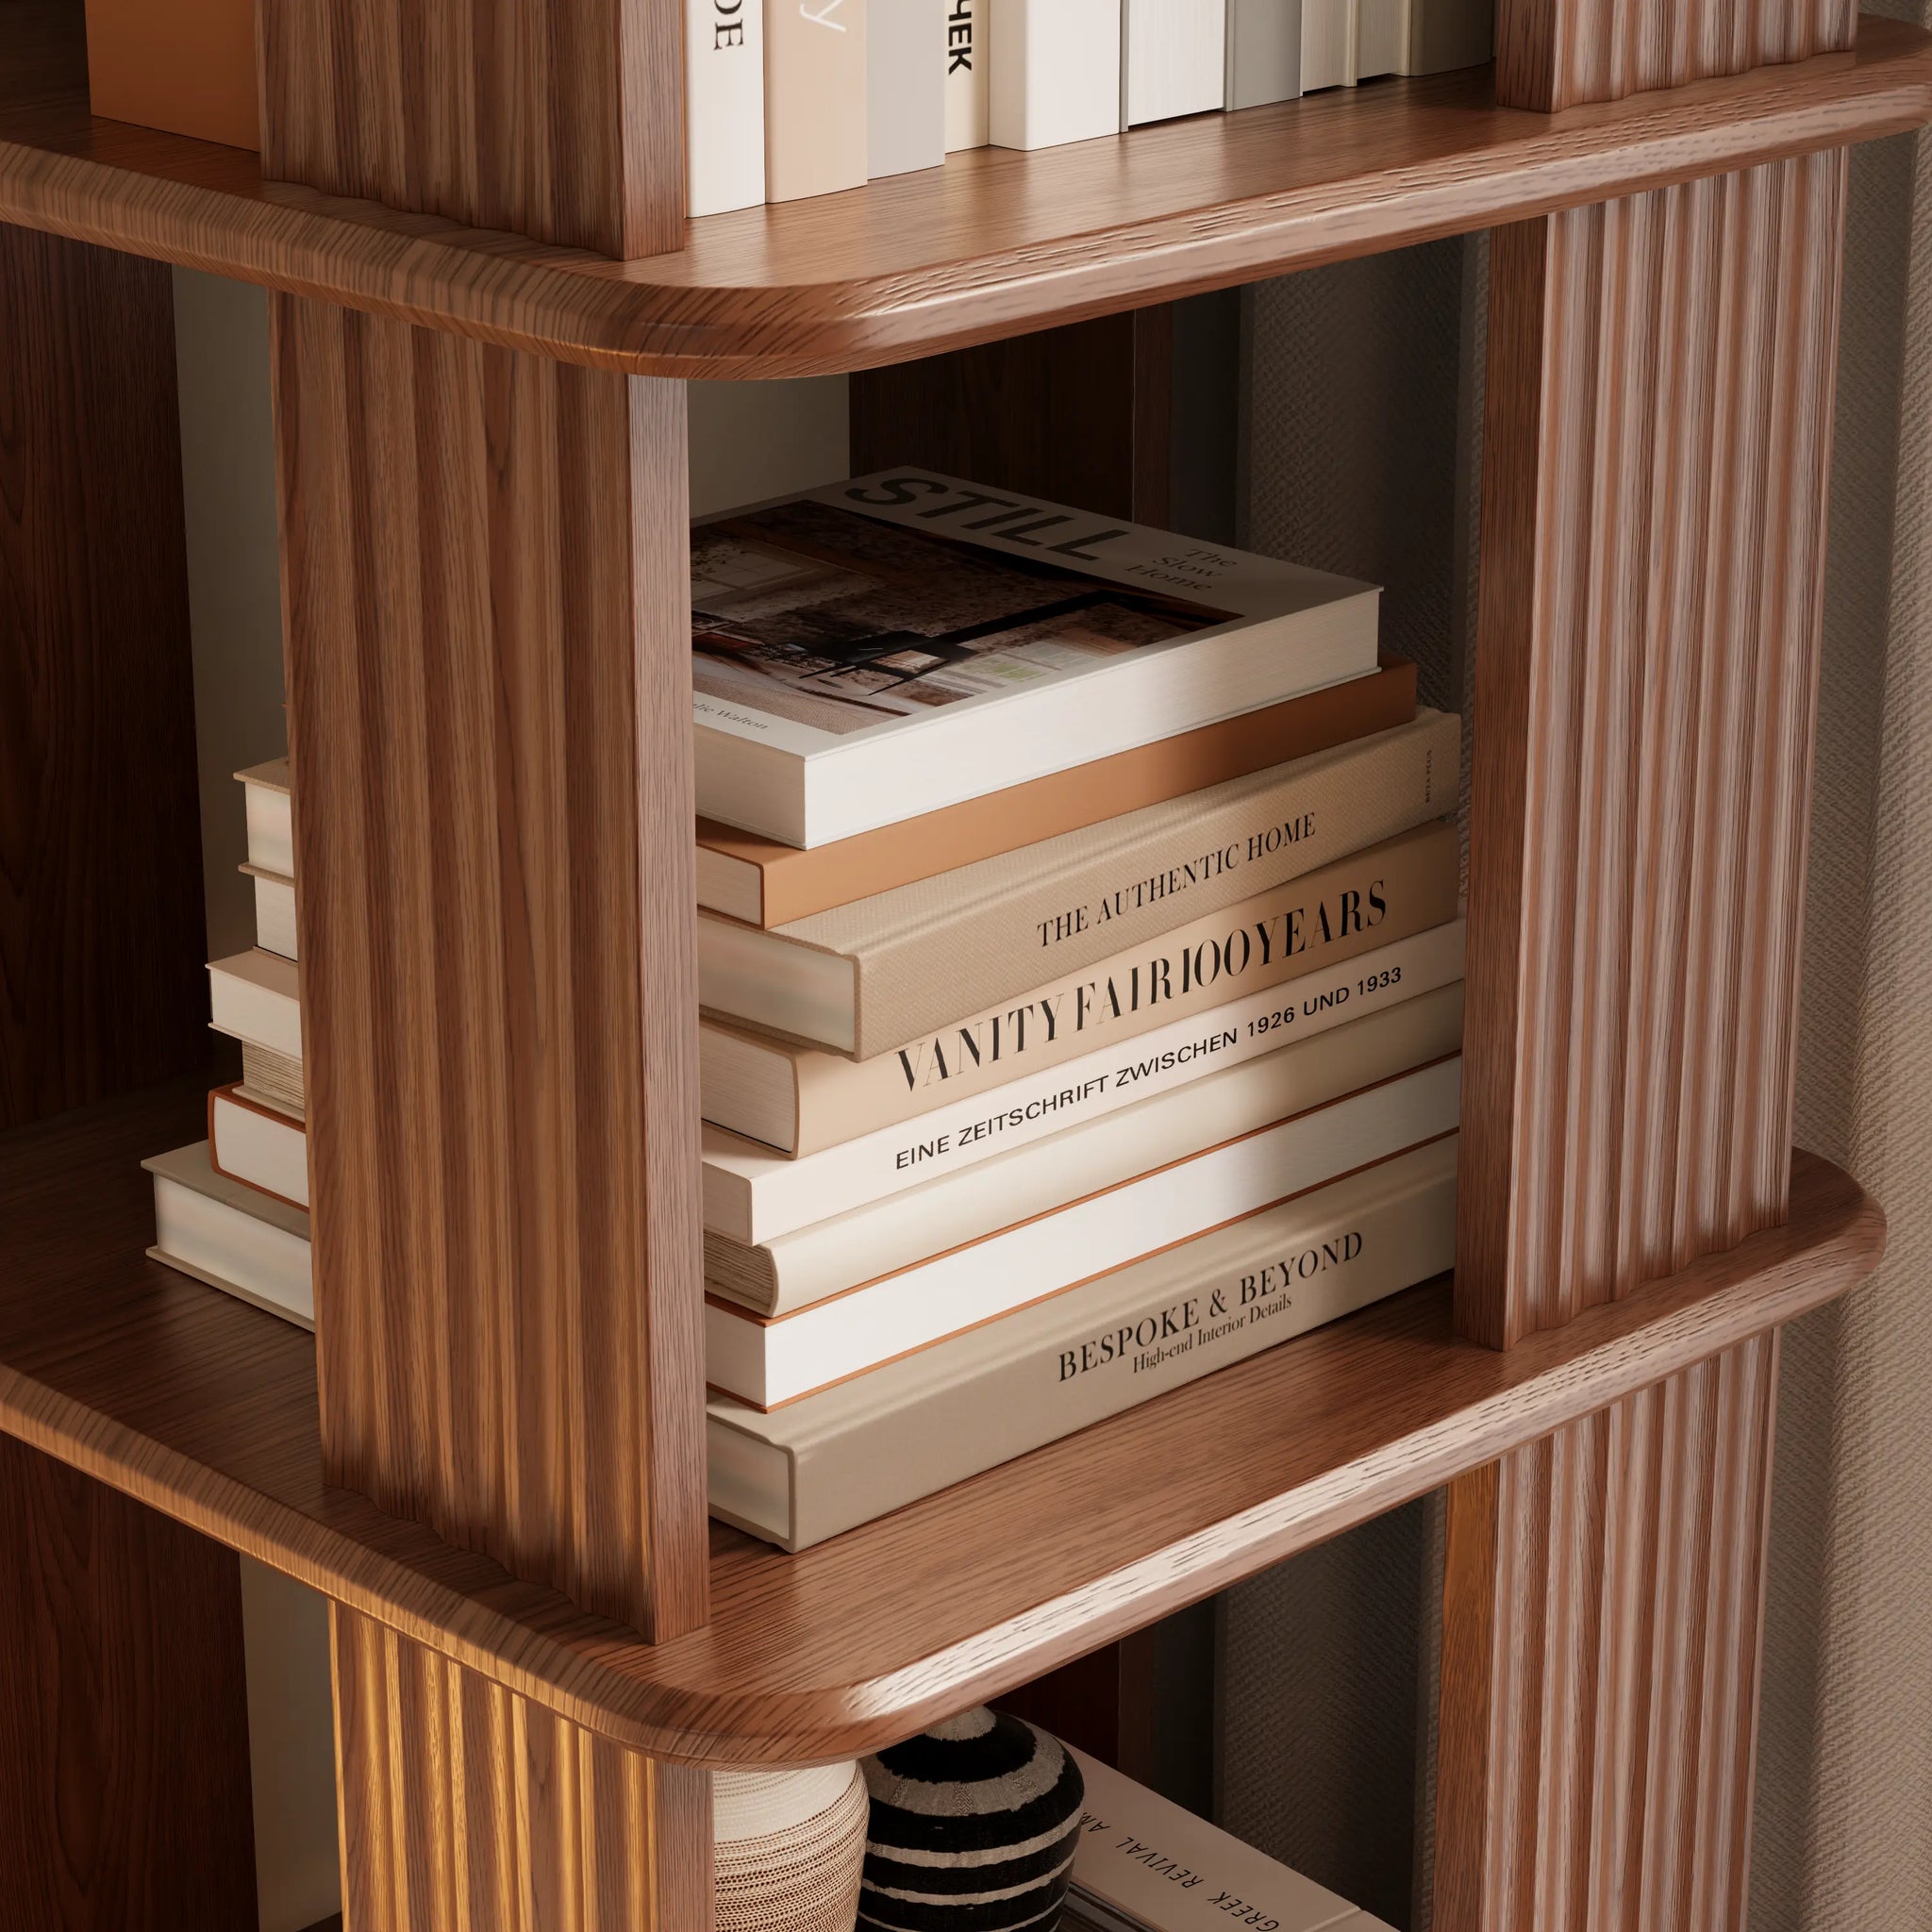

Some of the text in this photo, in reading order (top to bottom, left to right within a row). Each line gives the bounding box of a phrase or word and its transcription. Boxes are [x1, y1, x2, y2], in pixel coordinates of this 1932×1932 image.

[844, 477, 1129, 561] STILL
[1124, 564, 1212, 591] Home
[1152, 557, 1223, 576] Slow
[1185, 548, 1238, 567] The
[717, 709, 769, 729] Walton
[1037, 811, 1316, 948] THE AUTHENTIC HOME
[894, 993, 1064, 1092] VANITY
[1073, 958, 1174, 1033] FAIR
[1251, 879, 1388, 966] YEARS
[895, 966, 1403, 1171] EINE ZEITSCHRIFT ZWISCHEN 1926 UND 1933
[1058, 1231, 1363, 1382] BESPOKE & BEYOND
[1132, 1293, 1292, 1374] High-end Interior Details
[1115, 1836, 1205, 1889] REVIVAL
[1207, 1890, 1280, 1932] GREEK
